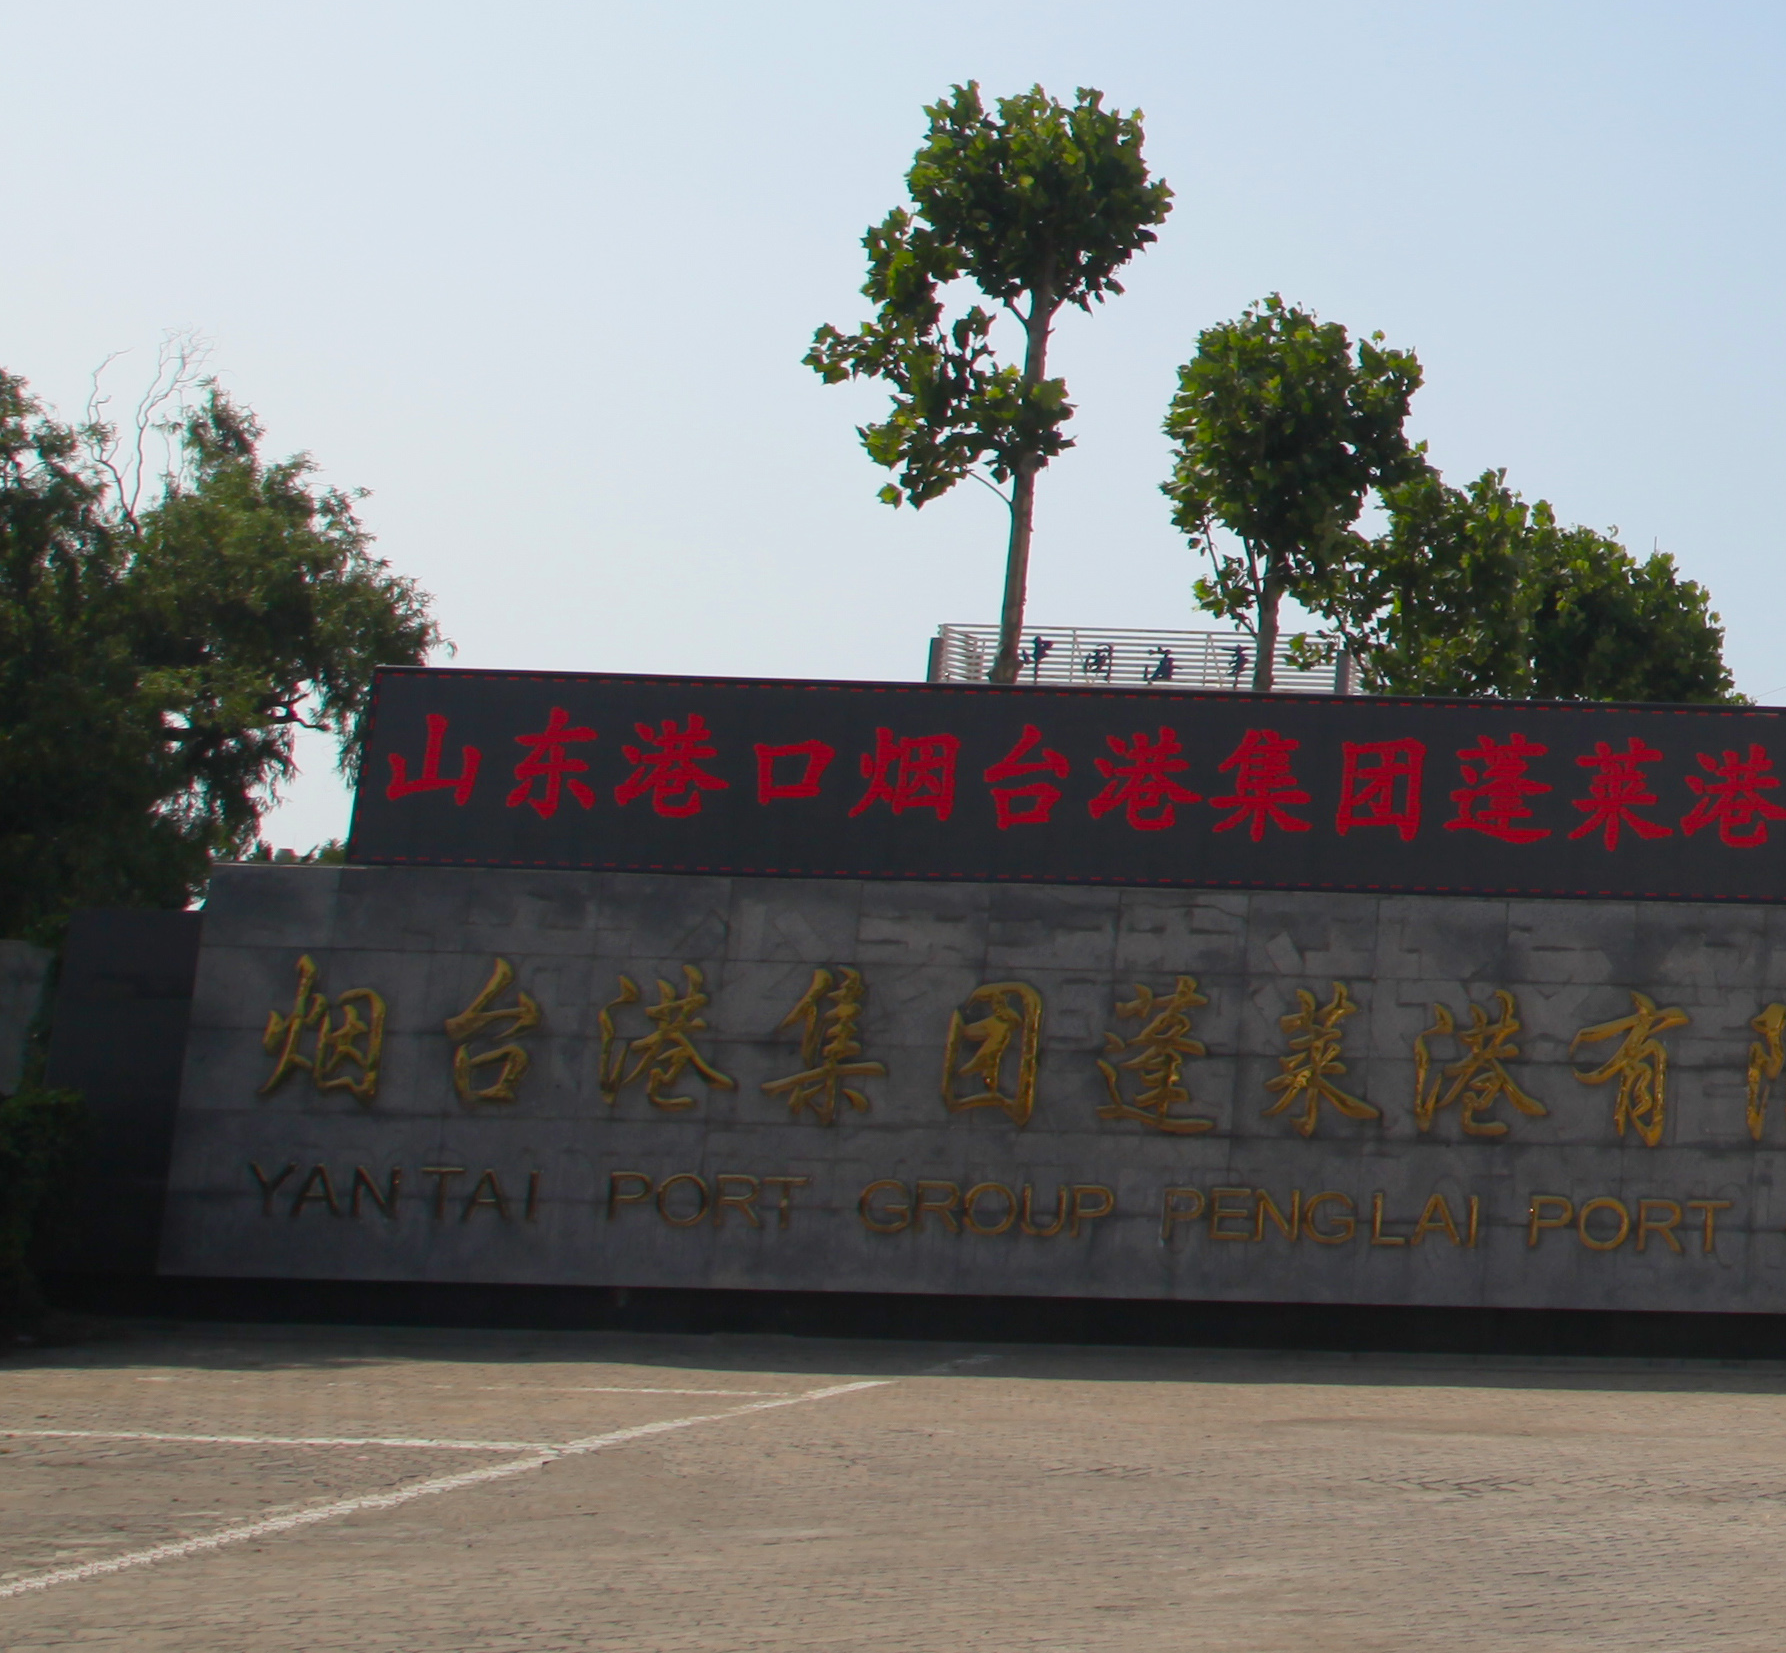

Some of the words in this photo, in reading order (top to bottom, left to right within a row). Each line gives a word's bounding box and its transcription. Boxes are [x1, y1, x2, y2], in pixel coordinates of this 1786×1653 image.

[607, 1171, 813, 1231] PORT
[858, 1178, 1117, 1238] GROUP
[1160, 1186, 1481, 1250] PENGLAI
[1526, 1194, 1734, 1254] PORT
